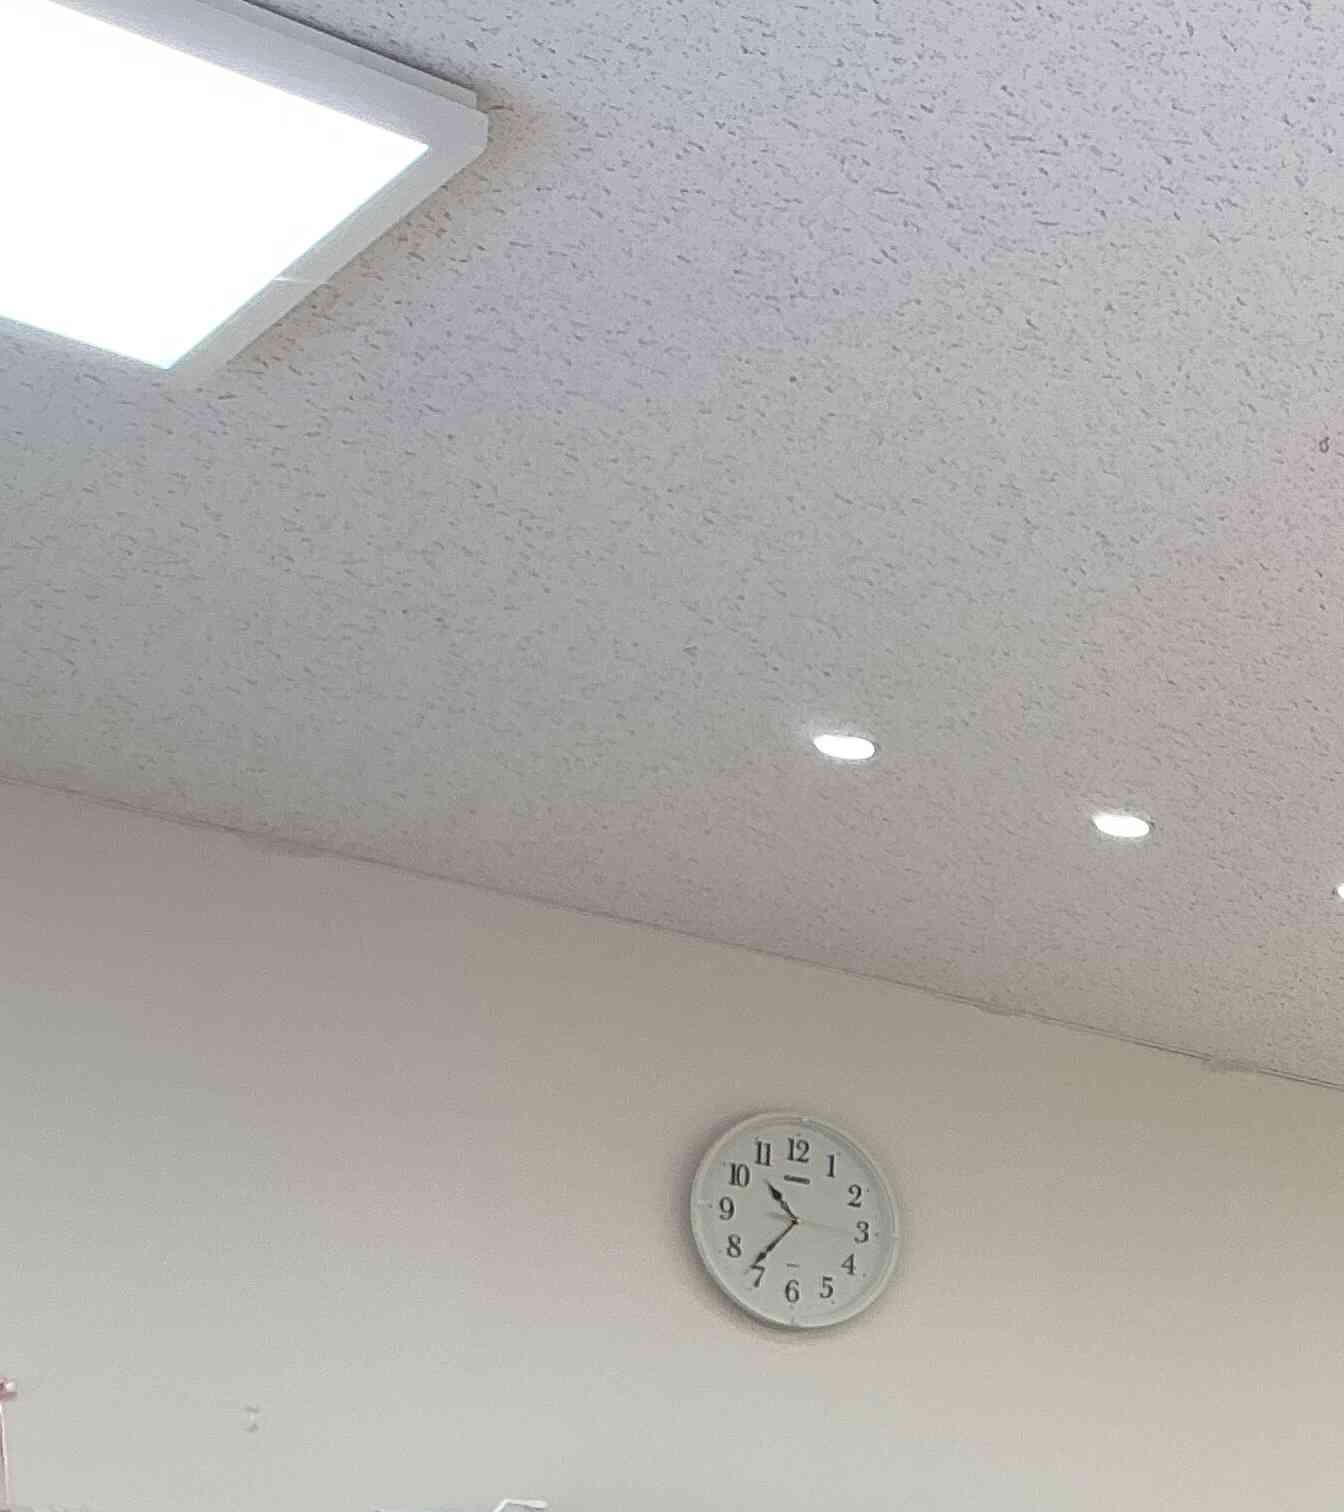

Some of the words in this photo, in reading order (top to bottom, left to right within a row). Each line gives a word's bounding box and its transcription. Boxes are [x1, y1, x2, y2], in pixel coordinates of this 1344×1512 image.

[754, 1140, 772, 1167] 11
[786, 1137, 810, 1163] 12
[729, 1163, 750, 1188] 10
[825, 1154, 836, 1178] 1
[847, 1184, 862, 1208] 2
[719, 1196, 735, 1221] 9
[854, 1221, 869, 1244] 3
[726, 1234, 742, 1258] 8
[750, 1264, 765, 1287] 7
[841, 1254, 855, 1275] 4
[785, 1280, 800, 1303] 6
[820, 1276, 834, 1299] 5
